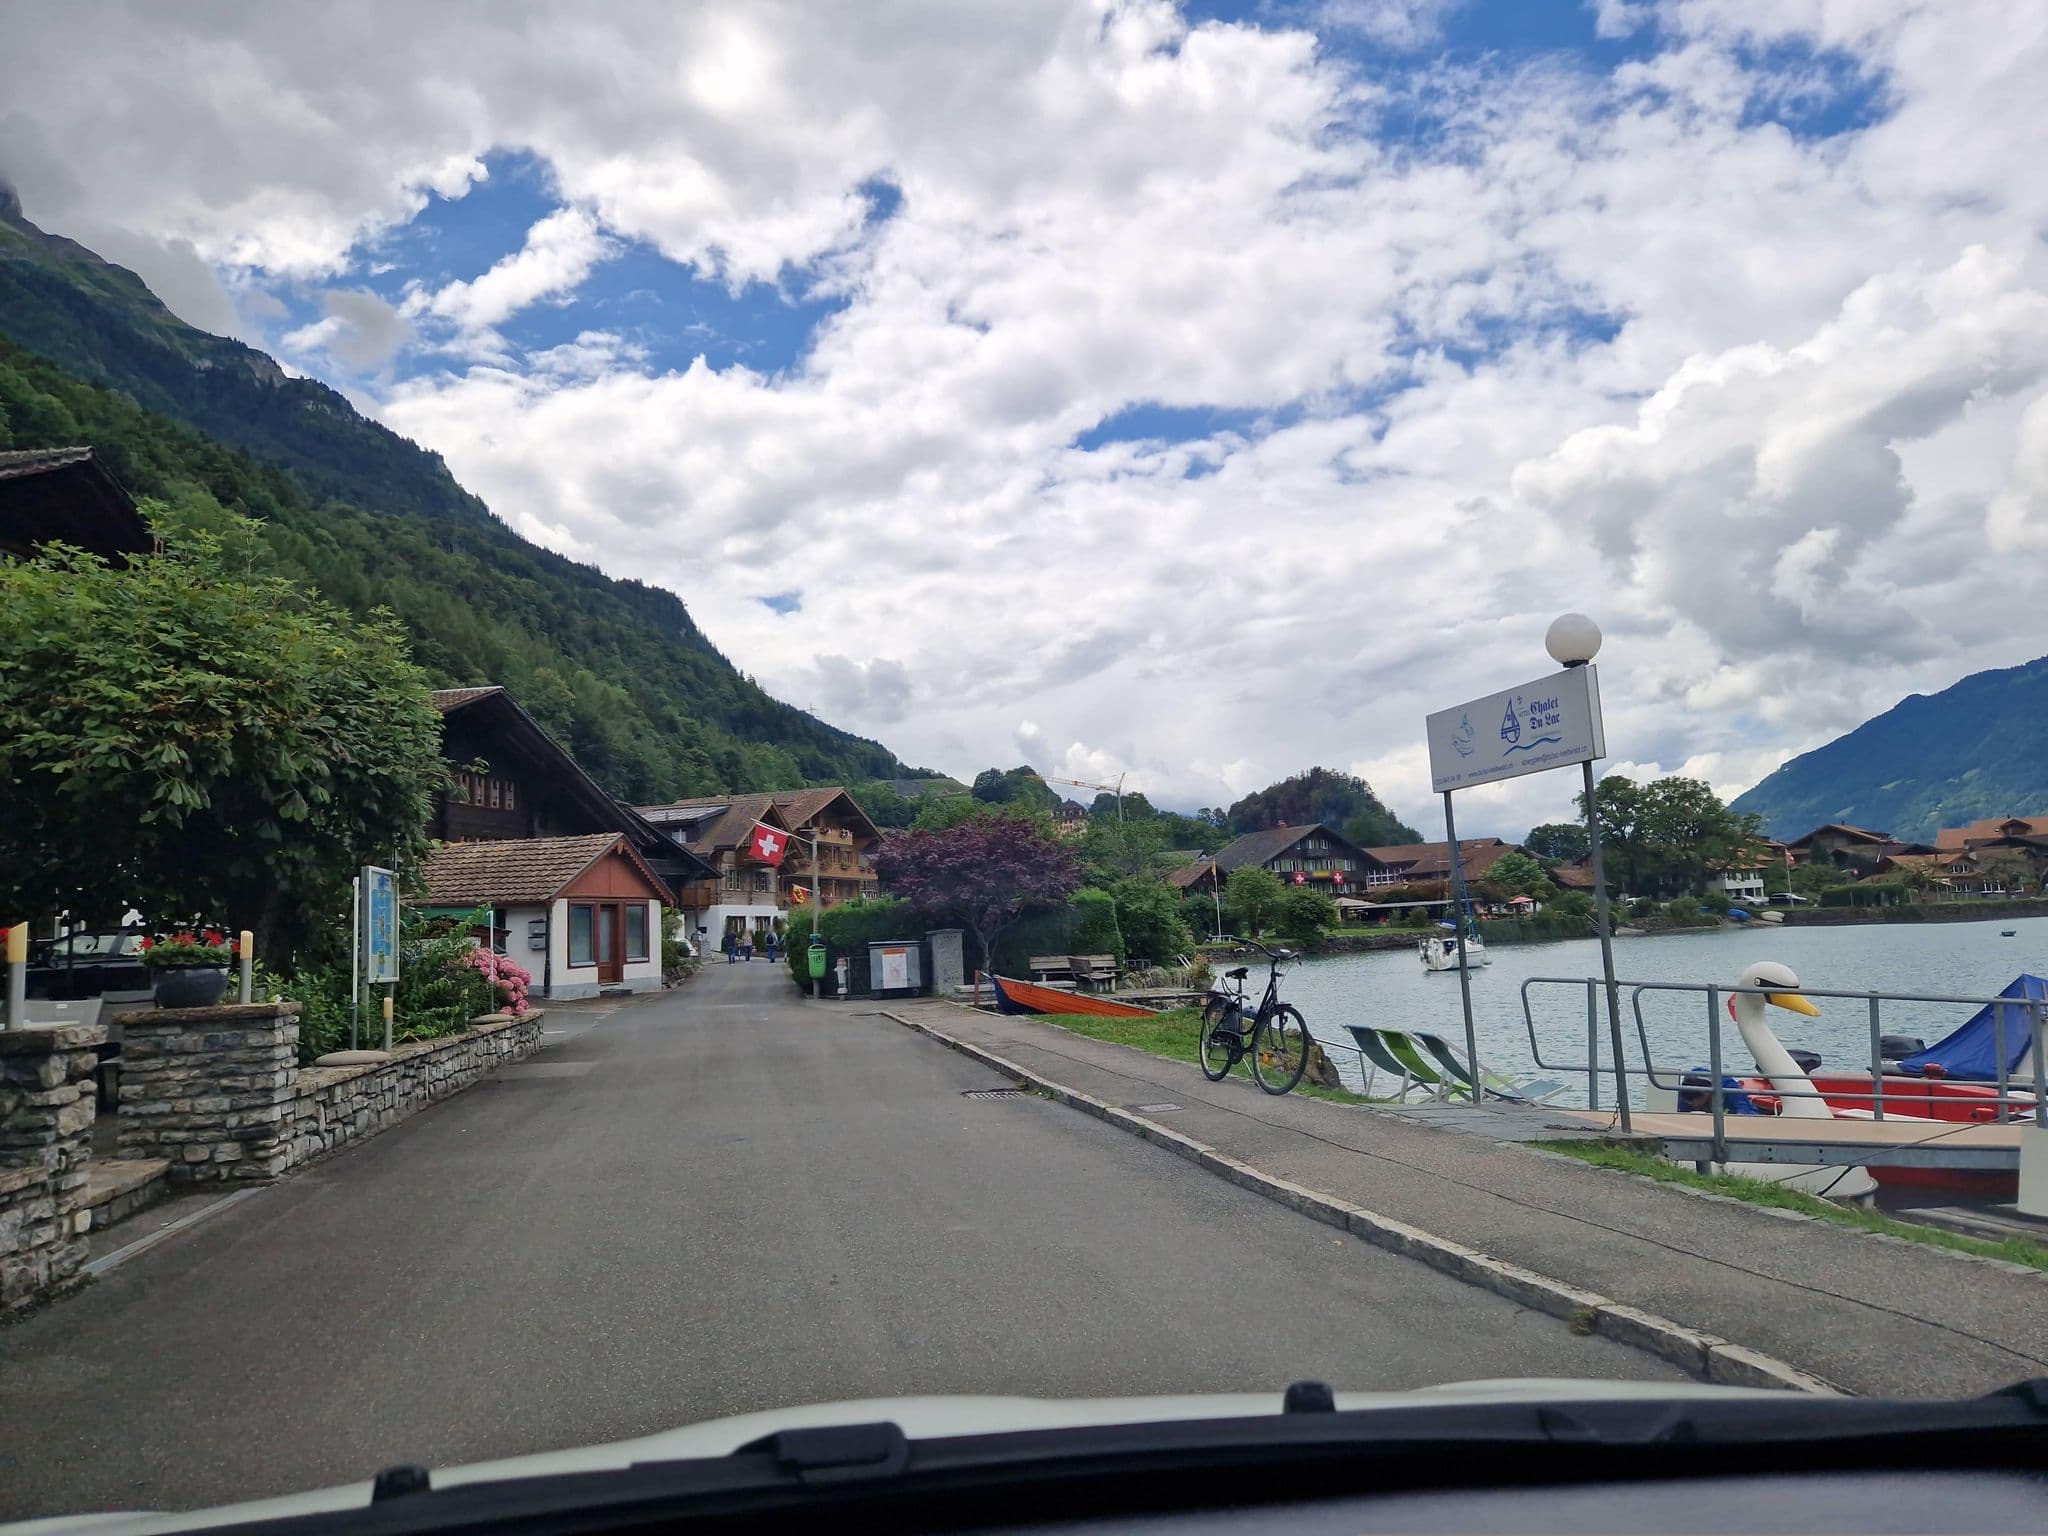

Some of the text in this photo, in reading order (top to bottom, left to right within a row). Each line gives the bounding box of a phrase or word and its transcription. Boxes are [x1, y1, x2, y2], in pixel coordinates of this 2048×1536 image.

[1530, 697, 1559, 714] Chalet
[1529, 712, 1560, 729] Du Lac
